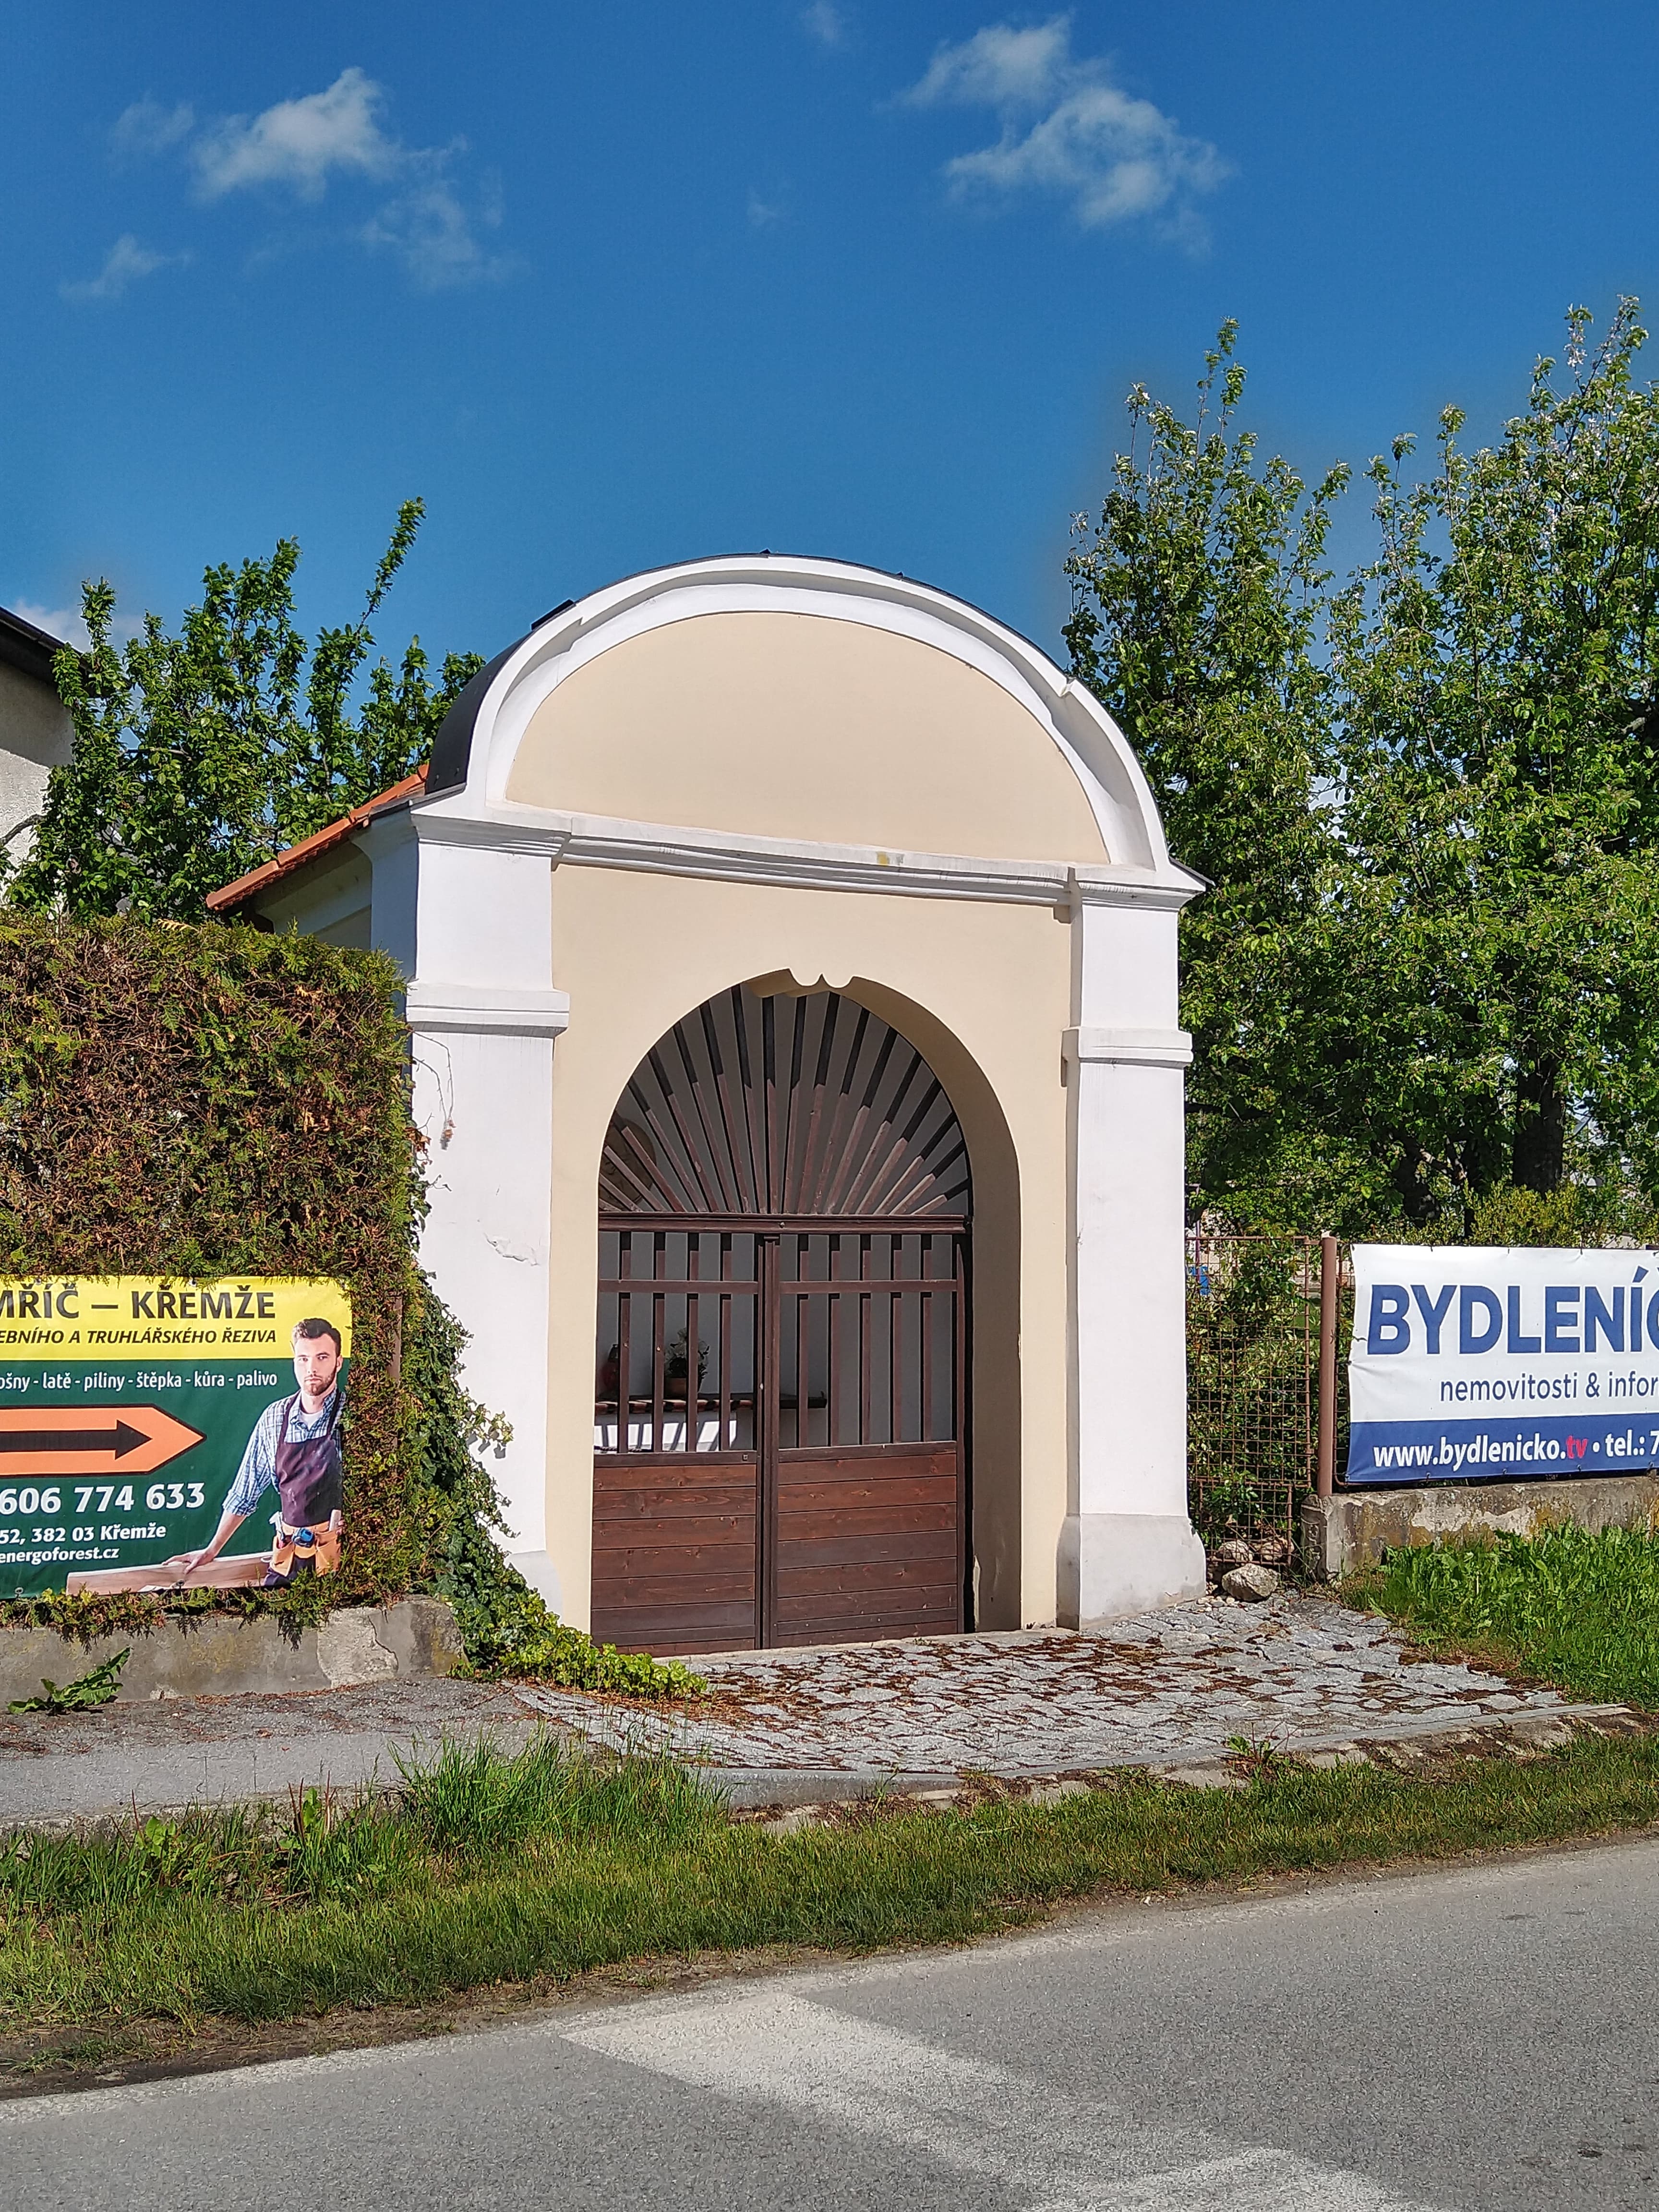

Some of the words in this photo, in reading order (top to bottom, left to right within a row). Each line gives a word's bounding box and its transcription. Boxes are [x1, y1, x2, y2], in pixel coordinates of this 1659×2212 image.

[132, 1285, 276, 1319] KŘEMŽE
[68, 1330, 80, 1344] A
[87, 1327, 216, 1344] TRUHLÁŘSKÉHO
[222, 1327, 276, 1343] ŘEZIVA
[43, 1372, 71, 1389] latě
[84, 1371, 125, 1392] piliny
[136, 1371, 181, 1391] štěpka
[194, 1371, 225, 1387] kůra
[237, 1370, 277, 1389] palivo
[1440, 1372, 1577, 1401] nemovitosti
[1586, 1372, 1600, 1397] &
[1373, 1433, 1587, 1471] www.bydlenicko.tv
[1605, 1429, 1645, 1457] tel.:
[0, 1488, 61, 1515] 606
[74, 1485, 134, 1512] 774
[146, 1482, 204, 1509] 633
[31, 1527, 66, 1542] 382
[72, 1527, 94, 1541] 03
[100, 1522, 166, 1540] Křemže
